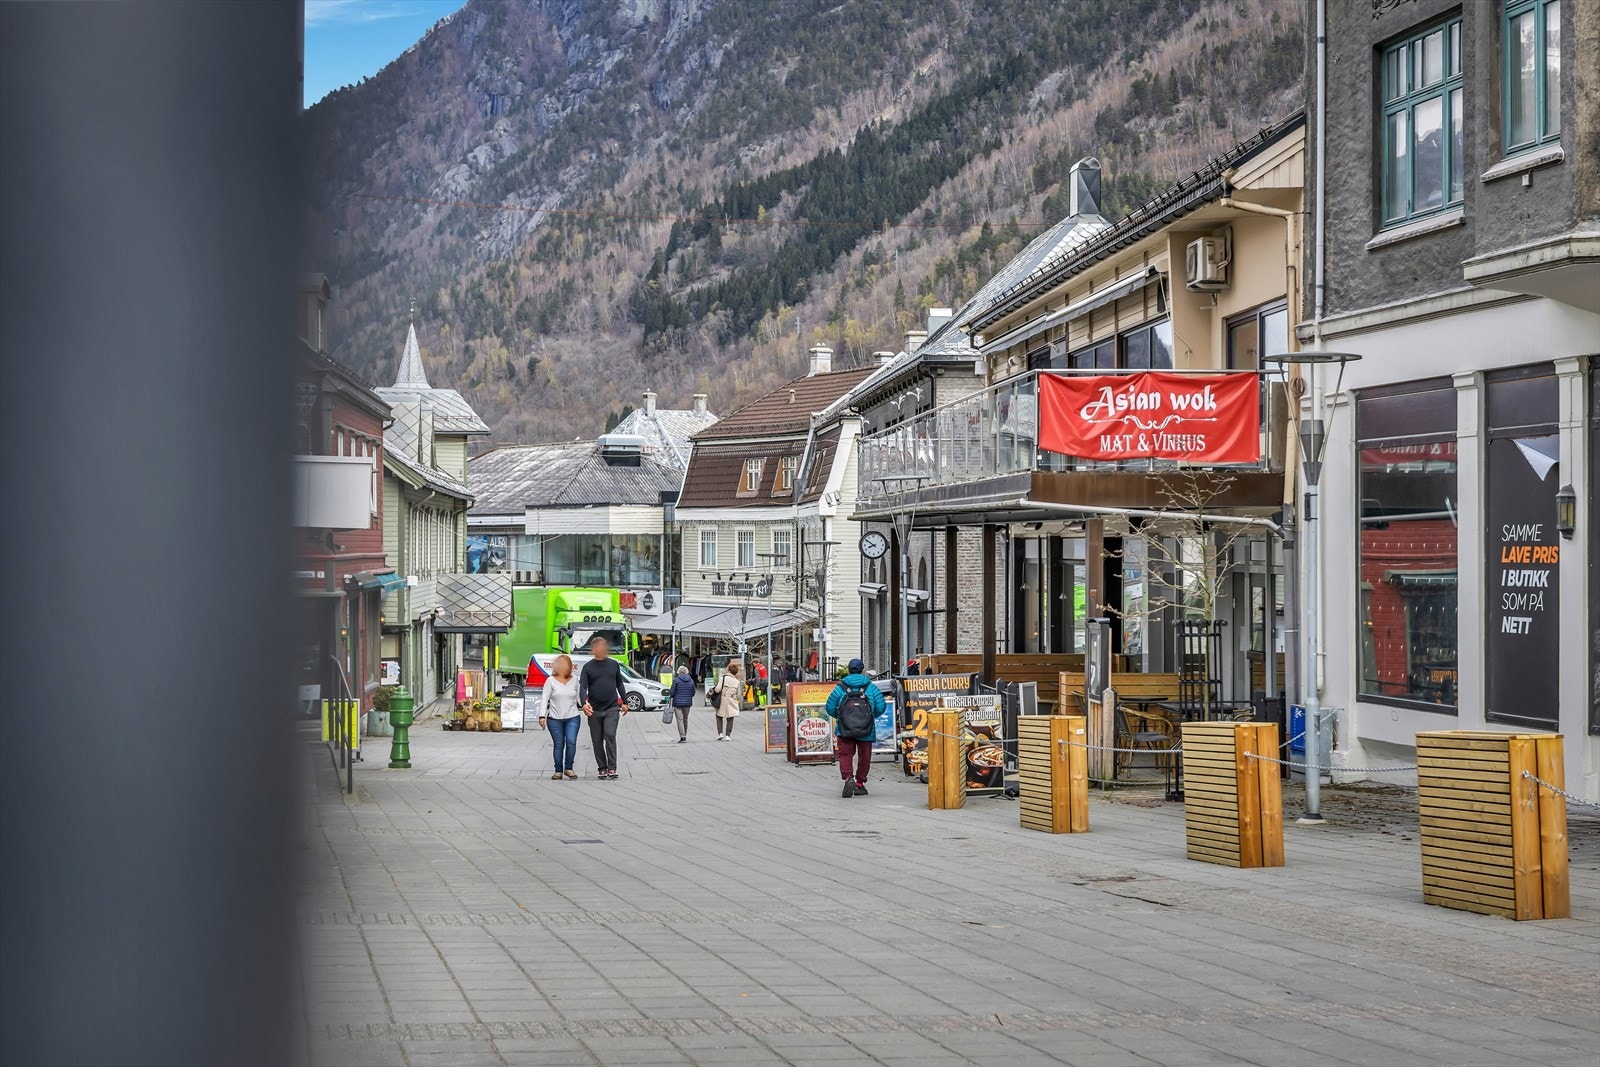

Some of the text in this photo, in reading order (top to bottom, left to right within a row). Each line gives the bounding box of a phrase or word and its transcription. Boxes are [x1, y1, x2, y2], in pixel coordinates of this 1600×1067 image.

[1080, 385, 1217, 420] Asian wok
[1100, 431, 1205, 452] MAT & VINHUS
[1501, 524, 1543, 542] SAMME
[1501, 545, 1559, 563] LAVE PRIS
[1501, 569, 1550, 587] I BUTIKK
[1501, 591, 1544, 611] SOM PÅ
[1501, 616, 1532, 634] NETT
[904, 677, 970, 692] MASALA CURRY
[947, 697, 973, 708] MASALA
[973, 696, 994, 706] CURRY
[800, 719, 826, 731] Asian
[965, 711, 1001, 721] ESTAURANT
